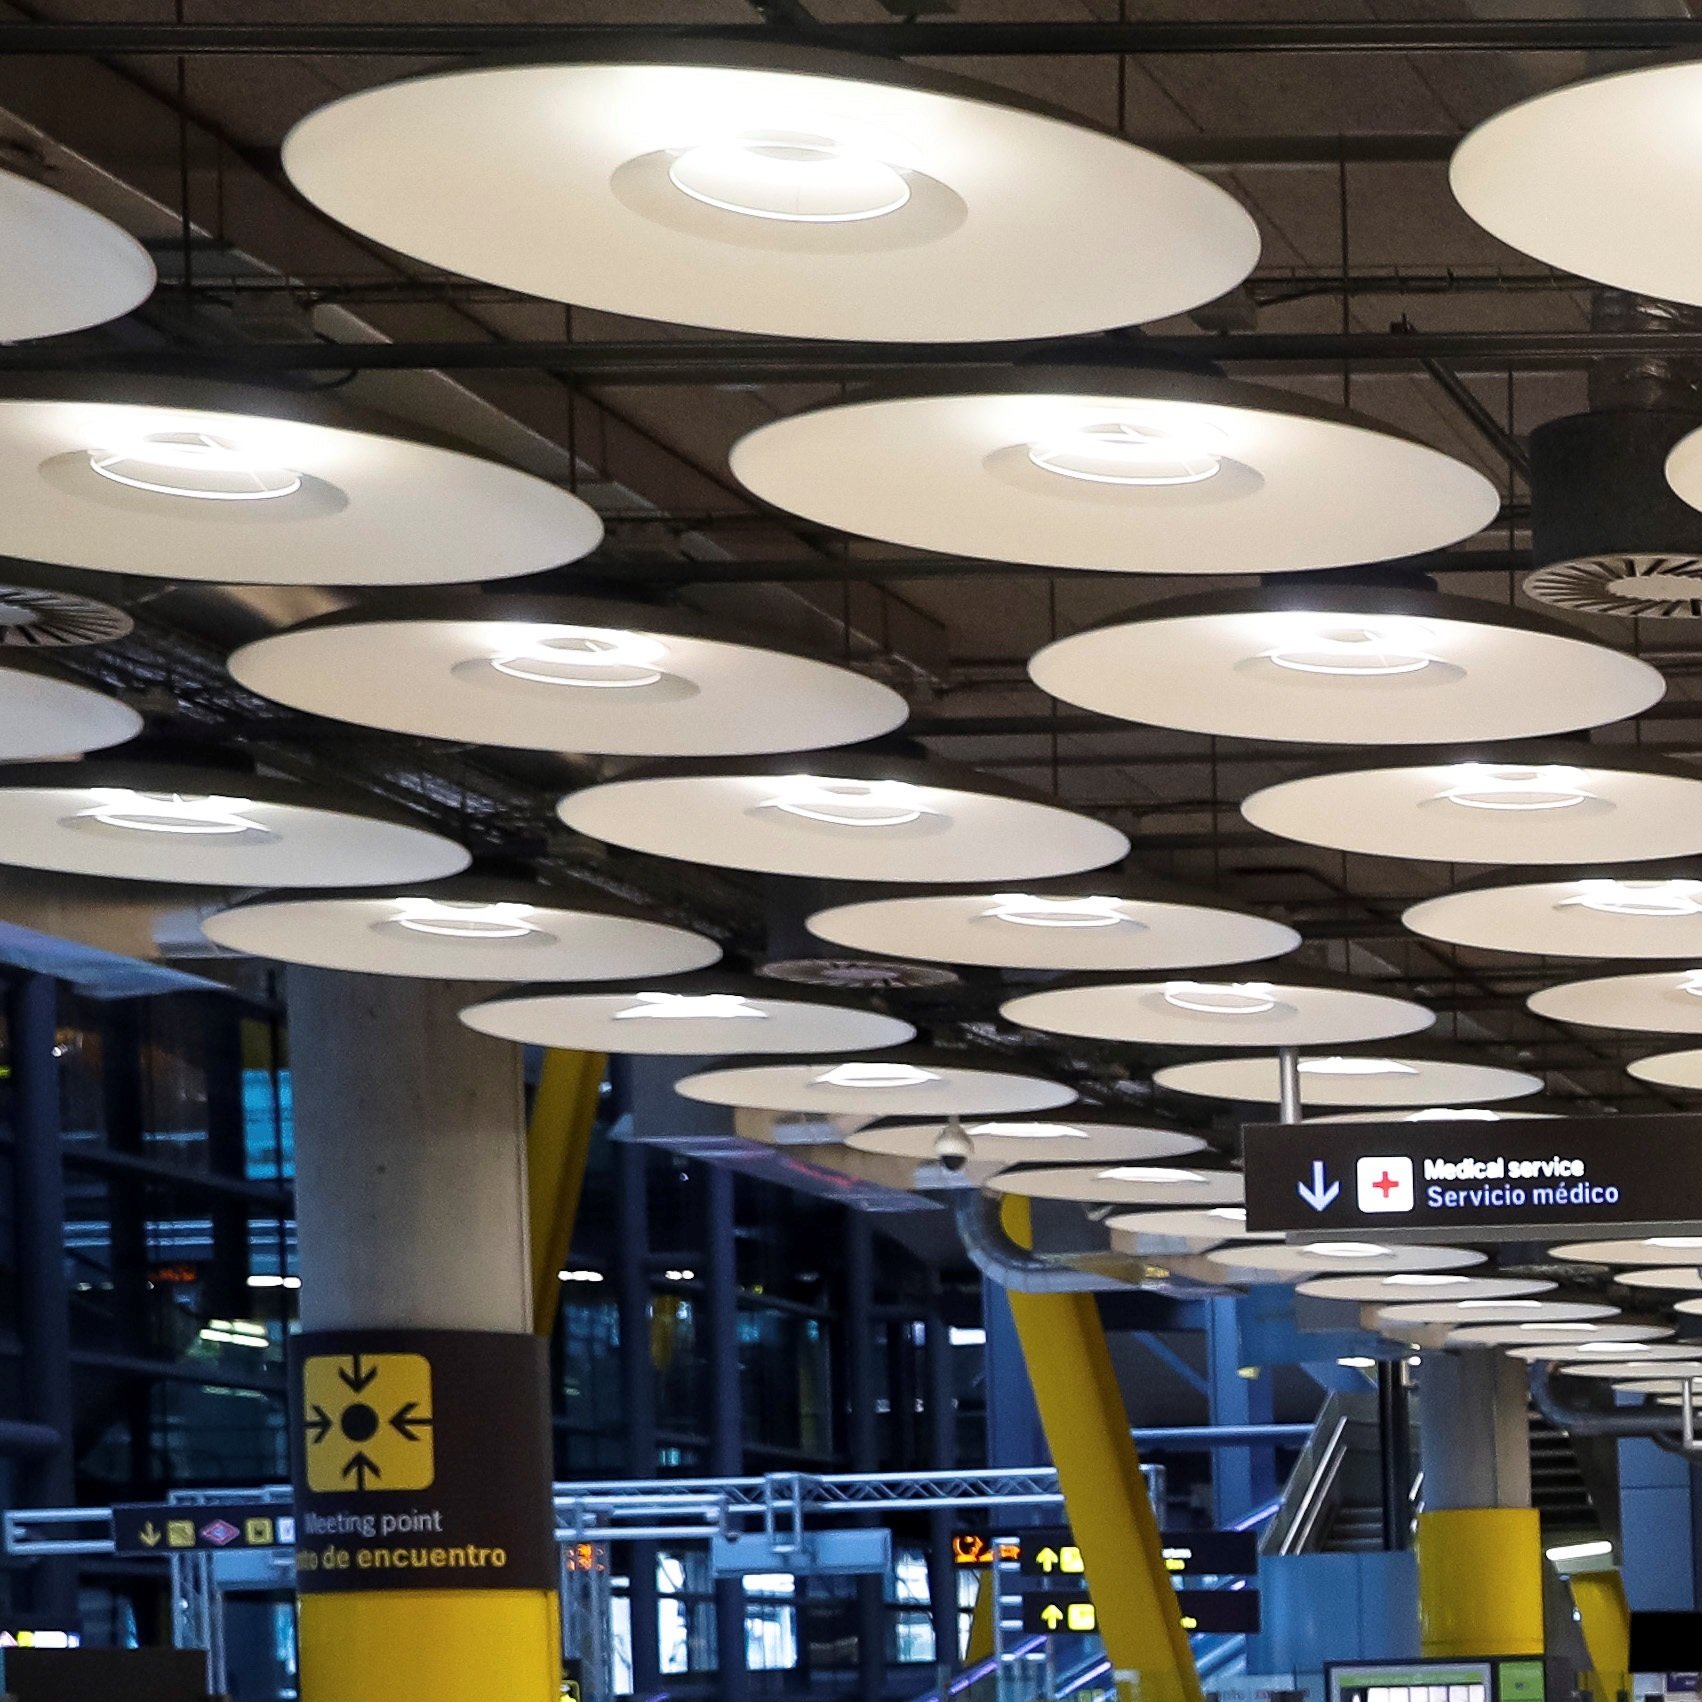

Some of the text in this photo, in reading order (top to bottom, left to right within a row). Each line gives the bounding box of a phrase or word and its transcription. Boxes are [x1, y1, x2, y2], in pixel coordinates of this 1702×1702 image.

[1424, 1156, 1585, 1180] Medical service
[1427, 1181, 1619, 1207] Servicio médico
[304, 1508, 443, 1538] Meeting point
[322, 1544, 350, 1569] de
[356, 1543, 508, 1568] encuentro
